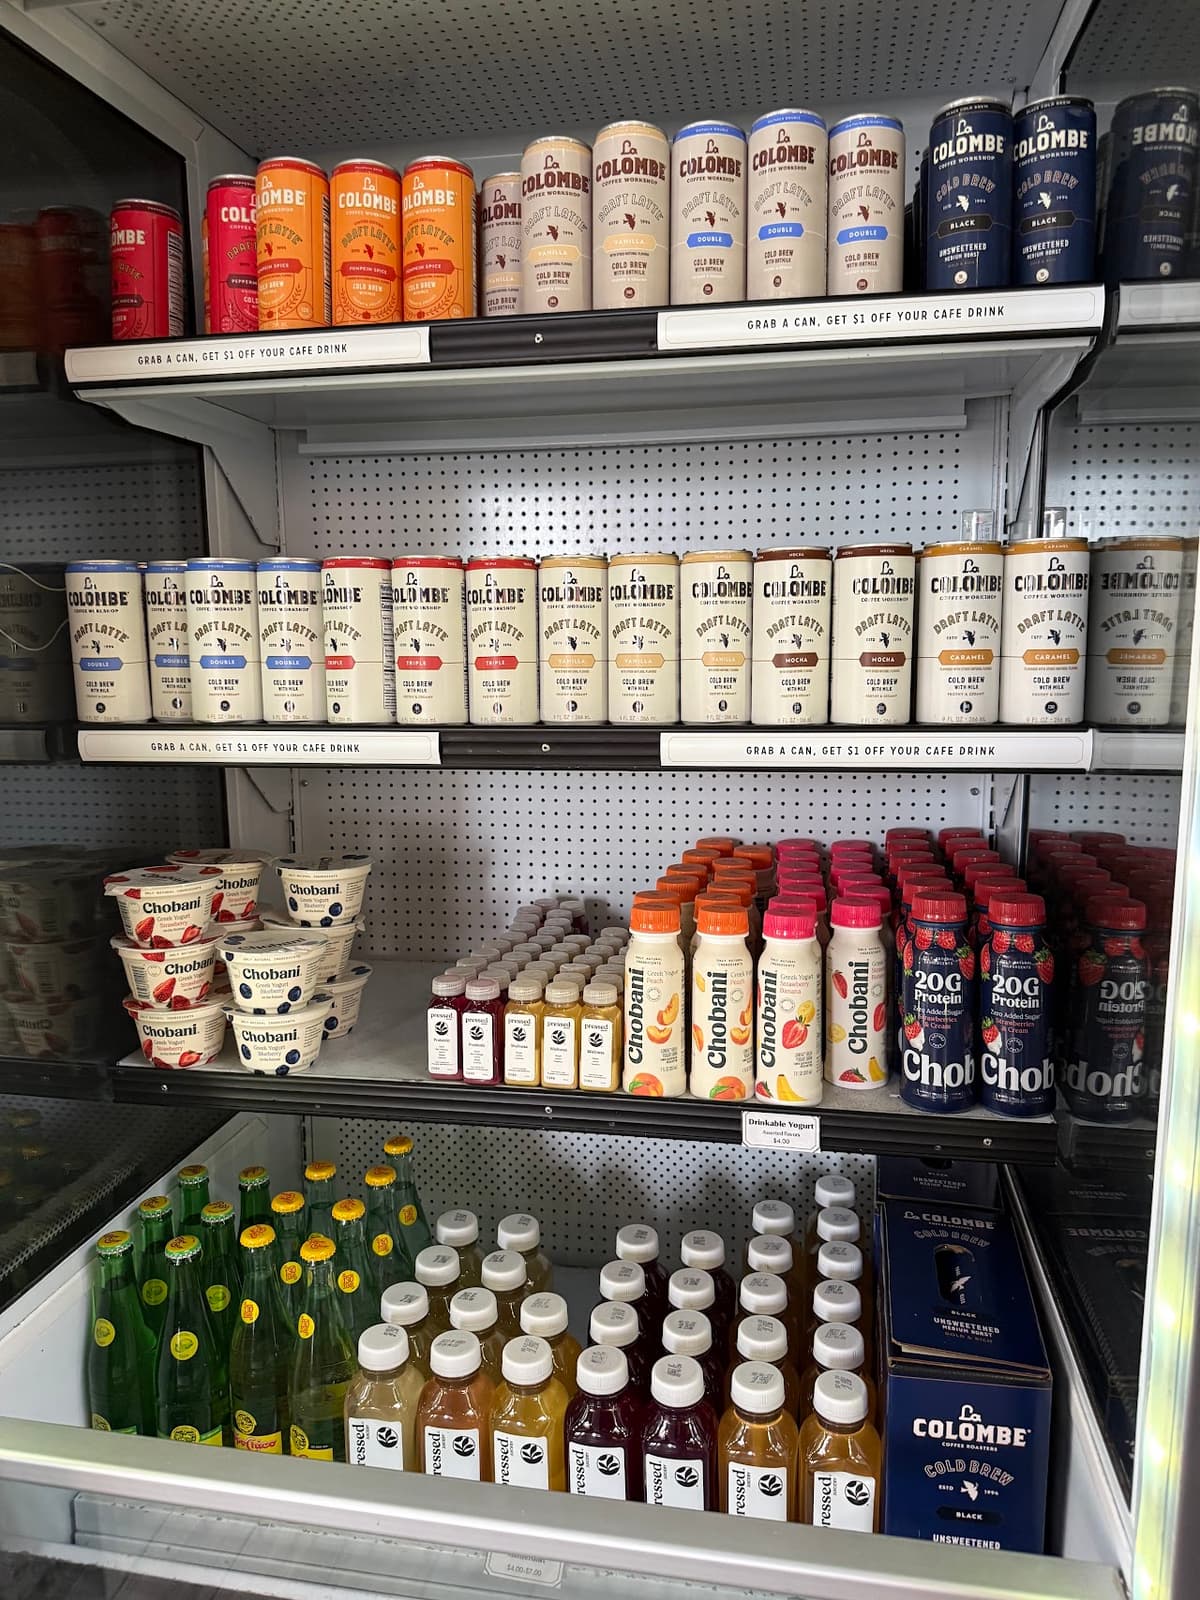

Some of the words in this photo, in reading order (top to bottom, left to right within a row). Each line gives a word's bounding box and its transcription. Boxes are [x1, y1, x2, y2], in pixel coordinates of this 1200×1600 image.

[956, 119, 972, 136] La
[1037, 115, 1055, 132] La
[934, 134, 1004, 165] COLOMBE
[1014, 130, 1087, 161] COLOMBE
[680, 157, 741, 177] COLOMBE
[753, 147, 815, 170] COLOMBE
[830, 150, 897, 176] COLOMBE
[596, 158, 665, 182] COLOMBE
[522, 172, 589, 196] COLOMBE
[339, 193, 397, 214] COLOMBE
[482, 203, 521, 223] OLOM
[951, 220, 975, 229] BLACK
[1032, 217, 1056, 227] BLACK
[849, 230, 877, 238] DOUBLE
[940, 243, 986, 257] UNSWEETENED
[1023, 240, 1069, 254] UNSWEETENED
[748, 319, 776, 329] GRAB
[782, 319, 789, 327] A
[794, 316, 820, 328] CAN,
[827, 314, 847, 325] GET
[853, 313, 866, 324] $1
[871, 312, 891, 322] OFF
[898, 310, 927, 321] YOUR
[934, 308, 962, 319] CAFE
[968, 306, 1004, 318] DRINK
[138, 353, 161, 365] GRAB
[167, 354, 172, 363] A
[176, 353, 198, 363] CAN,
[202, 351, 219, 361] GET
[224, 350, 234, 360] $1
[239, 349, 255, 359] OFF
[260, 347, 285, 357] YOUR
[290, 345, 313, 355] CAFE
[318, 344, 347, 354] DRINK
[693, 582, 752, 598] COLOMBE
[764, 581, 826, 598] COLOMBE
[853, 577, 913, 594] COLOMBE
[931, 576, 1001, 594] COLOMBE
[1015, 574, 1088, 591] COLOMBE
[69, 592, 128, 606] COLOMBE
[190, 590, 251, 604] COLOMBE
[259, 590, 317, 605] COLOMBE
[542, 587, 602, 602] COLOMBE
[611, 585, 673, 600] COLOMBE
[1017, 610, 1053, 633] DRAFT
[1057, 610, 1085, 632] LATTE
[151, 743, 175, 752] GRAB
[180, 743, 185, 752] A
[189, 743, 212, 753] CAN,
[216, 743, 232, 752] GET
[237, 743, 247, 752] $1
[252, 744, 268, 752] OFF
[274, 744, 298, 752] YOUR
[303, 744, 326, 752] CAFE
[331, 744, 360, 753] DRINK
[746, 746, 774, 756] GRAB
[780, 746, 785, 756] A
[790, 746, 816, 757] CAN,
[822, 746, 842, 756] GET
[847, 746, 859, 756] $1
[865, 746, 885, 756] OFF
[890, 746, 920, 756] YOUR
[926, 746, 953, 756] CAFE
[959, 746, 995, 756] DRINK
[290, 884, 339, 895] Chobani
[143, 897, 200, 913] Chobani
[243, 965, 300, 980] Chobani
[915, 971, 961, 992] 20G
[992, 974, 1039, 996] 20G
[914, 989, 961, 1004] Protein
[992, 992, 1039, 1008] Protein
[629, 968, 643, 1064] Chobani
[848, 961, 869, 1054] Chobani
[708, 972, 727, 1068] Chobani
[761, 970, 777, 1067] Chobani
[143, 1024, 196, 1037] Chobani
[242, 1029, 297, 1042] Chobani
[749, 1119, 786, 1127] Drinkable
[789, 1121, 814, 1130] Yogurt
[904, 1211, 920, 1220] La
[922, 1213, 995, 1229] COLOMBE
[951, 1310, 976, 1318] BLACK
[934, 1317, 999, 1333] UNSWEETENED
[943, 1325, 968, 1333] MEDIUM
[959, 1405, 981, 1422] La
[913, 1418, 1027, 1447] COLOMBE
[966, 1444, 997, 1452] ROASTERS
[497, 1438, 509, 1485] ressed
[924, 1459, 965, 1478] COLD
[969, 1460, 1014, 1486] BREW
[818, 1477, 831, 1528] ressed
[956, 1512, 982, 1520] BLACK
[933, 1534, 1000, 1550] UNSWEETENED
